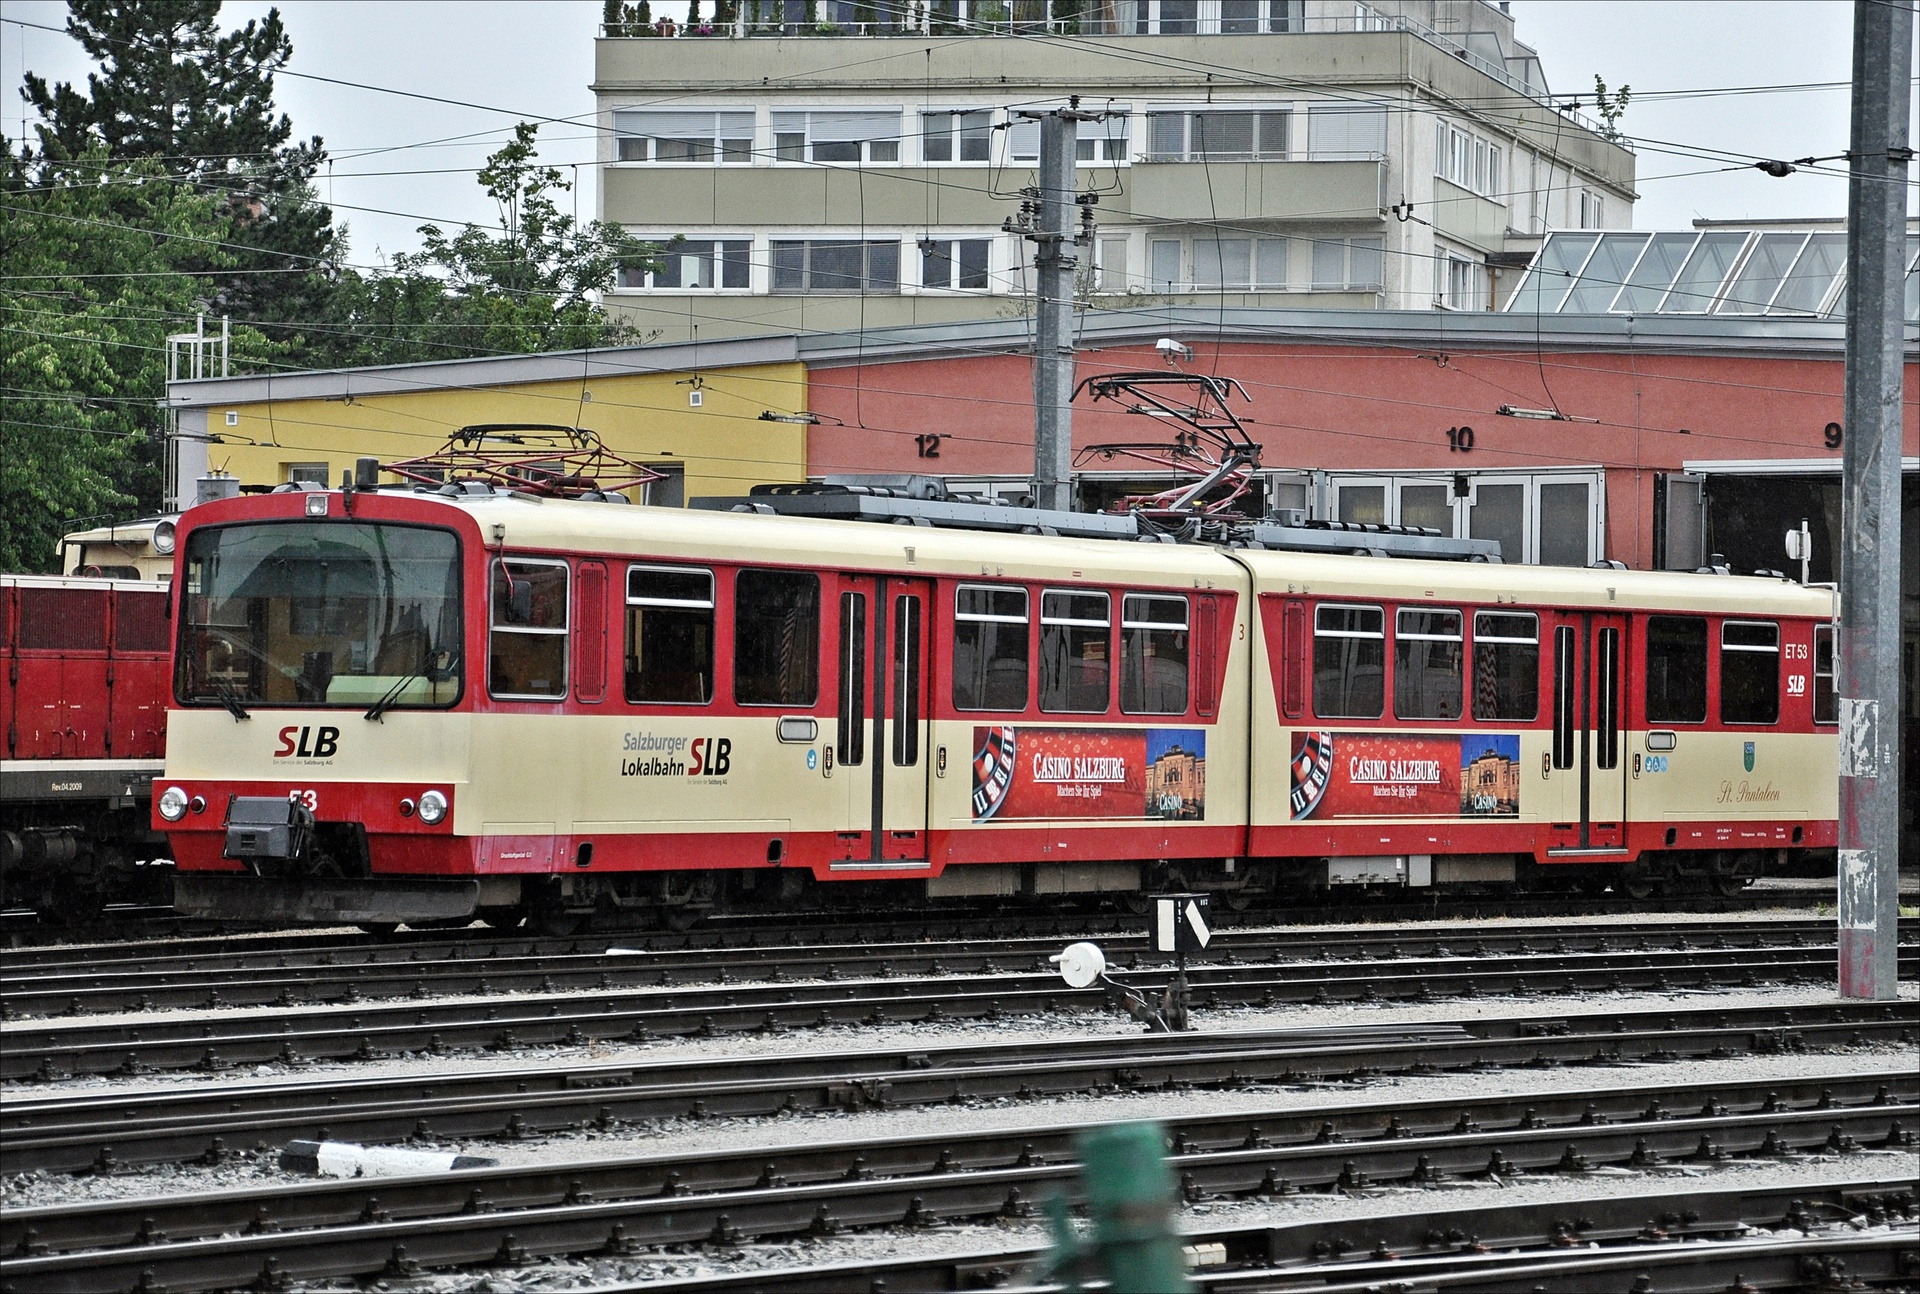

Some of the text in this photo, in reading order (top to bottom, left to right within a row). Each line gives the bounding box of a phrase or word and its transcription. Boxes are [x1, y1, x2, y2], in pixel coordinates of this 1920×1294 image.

[914, 433, 940, 458] 12
[1445, 426, 1474, 452] 10
[1824, 422, 1842, 449] 9
[1239, 623, 1245, 640] 3
[1785, 643, 1808, 660] ET 53
[1787, 675, 1805, 693] SLB
[274, 726, 340, 757] SLB
[623, 732, 688, 755] Salzburger
[621, 757, 684, 776] Lokalbahn
[688, 738, 731, 776] SLB
[1033, 752, 1125, 779] CASINO SALZBURG
[1350, 755, 1440, 780] CASINO SALZBURG
[51, 783, 82, 791] Rev.04.2009
[1057, 785, 1074, 797] Machen
[1090, 785, 1102, 800] Spiel
[1373, 785, 1390, 797] Machen
[1406, 785, 1417, 799] Spiel
[1717, 780, 1780, 803] St. Pantaleon
[290, 790, 317, 812] 53
[974, 790, 988, 814] 11
[1160, 793, 1182, 811] CASINO
[1292, 790, 1306, 812] 11
[1475, 793, 1497, 810] CASINO
